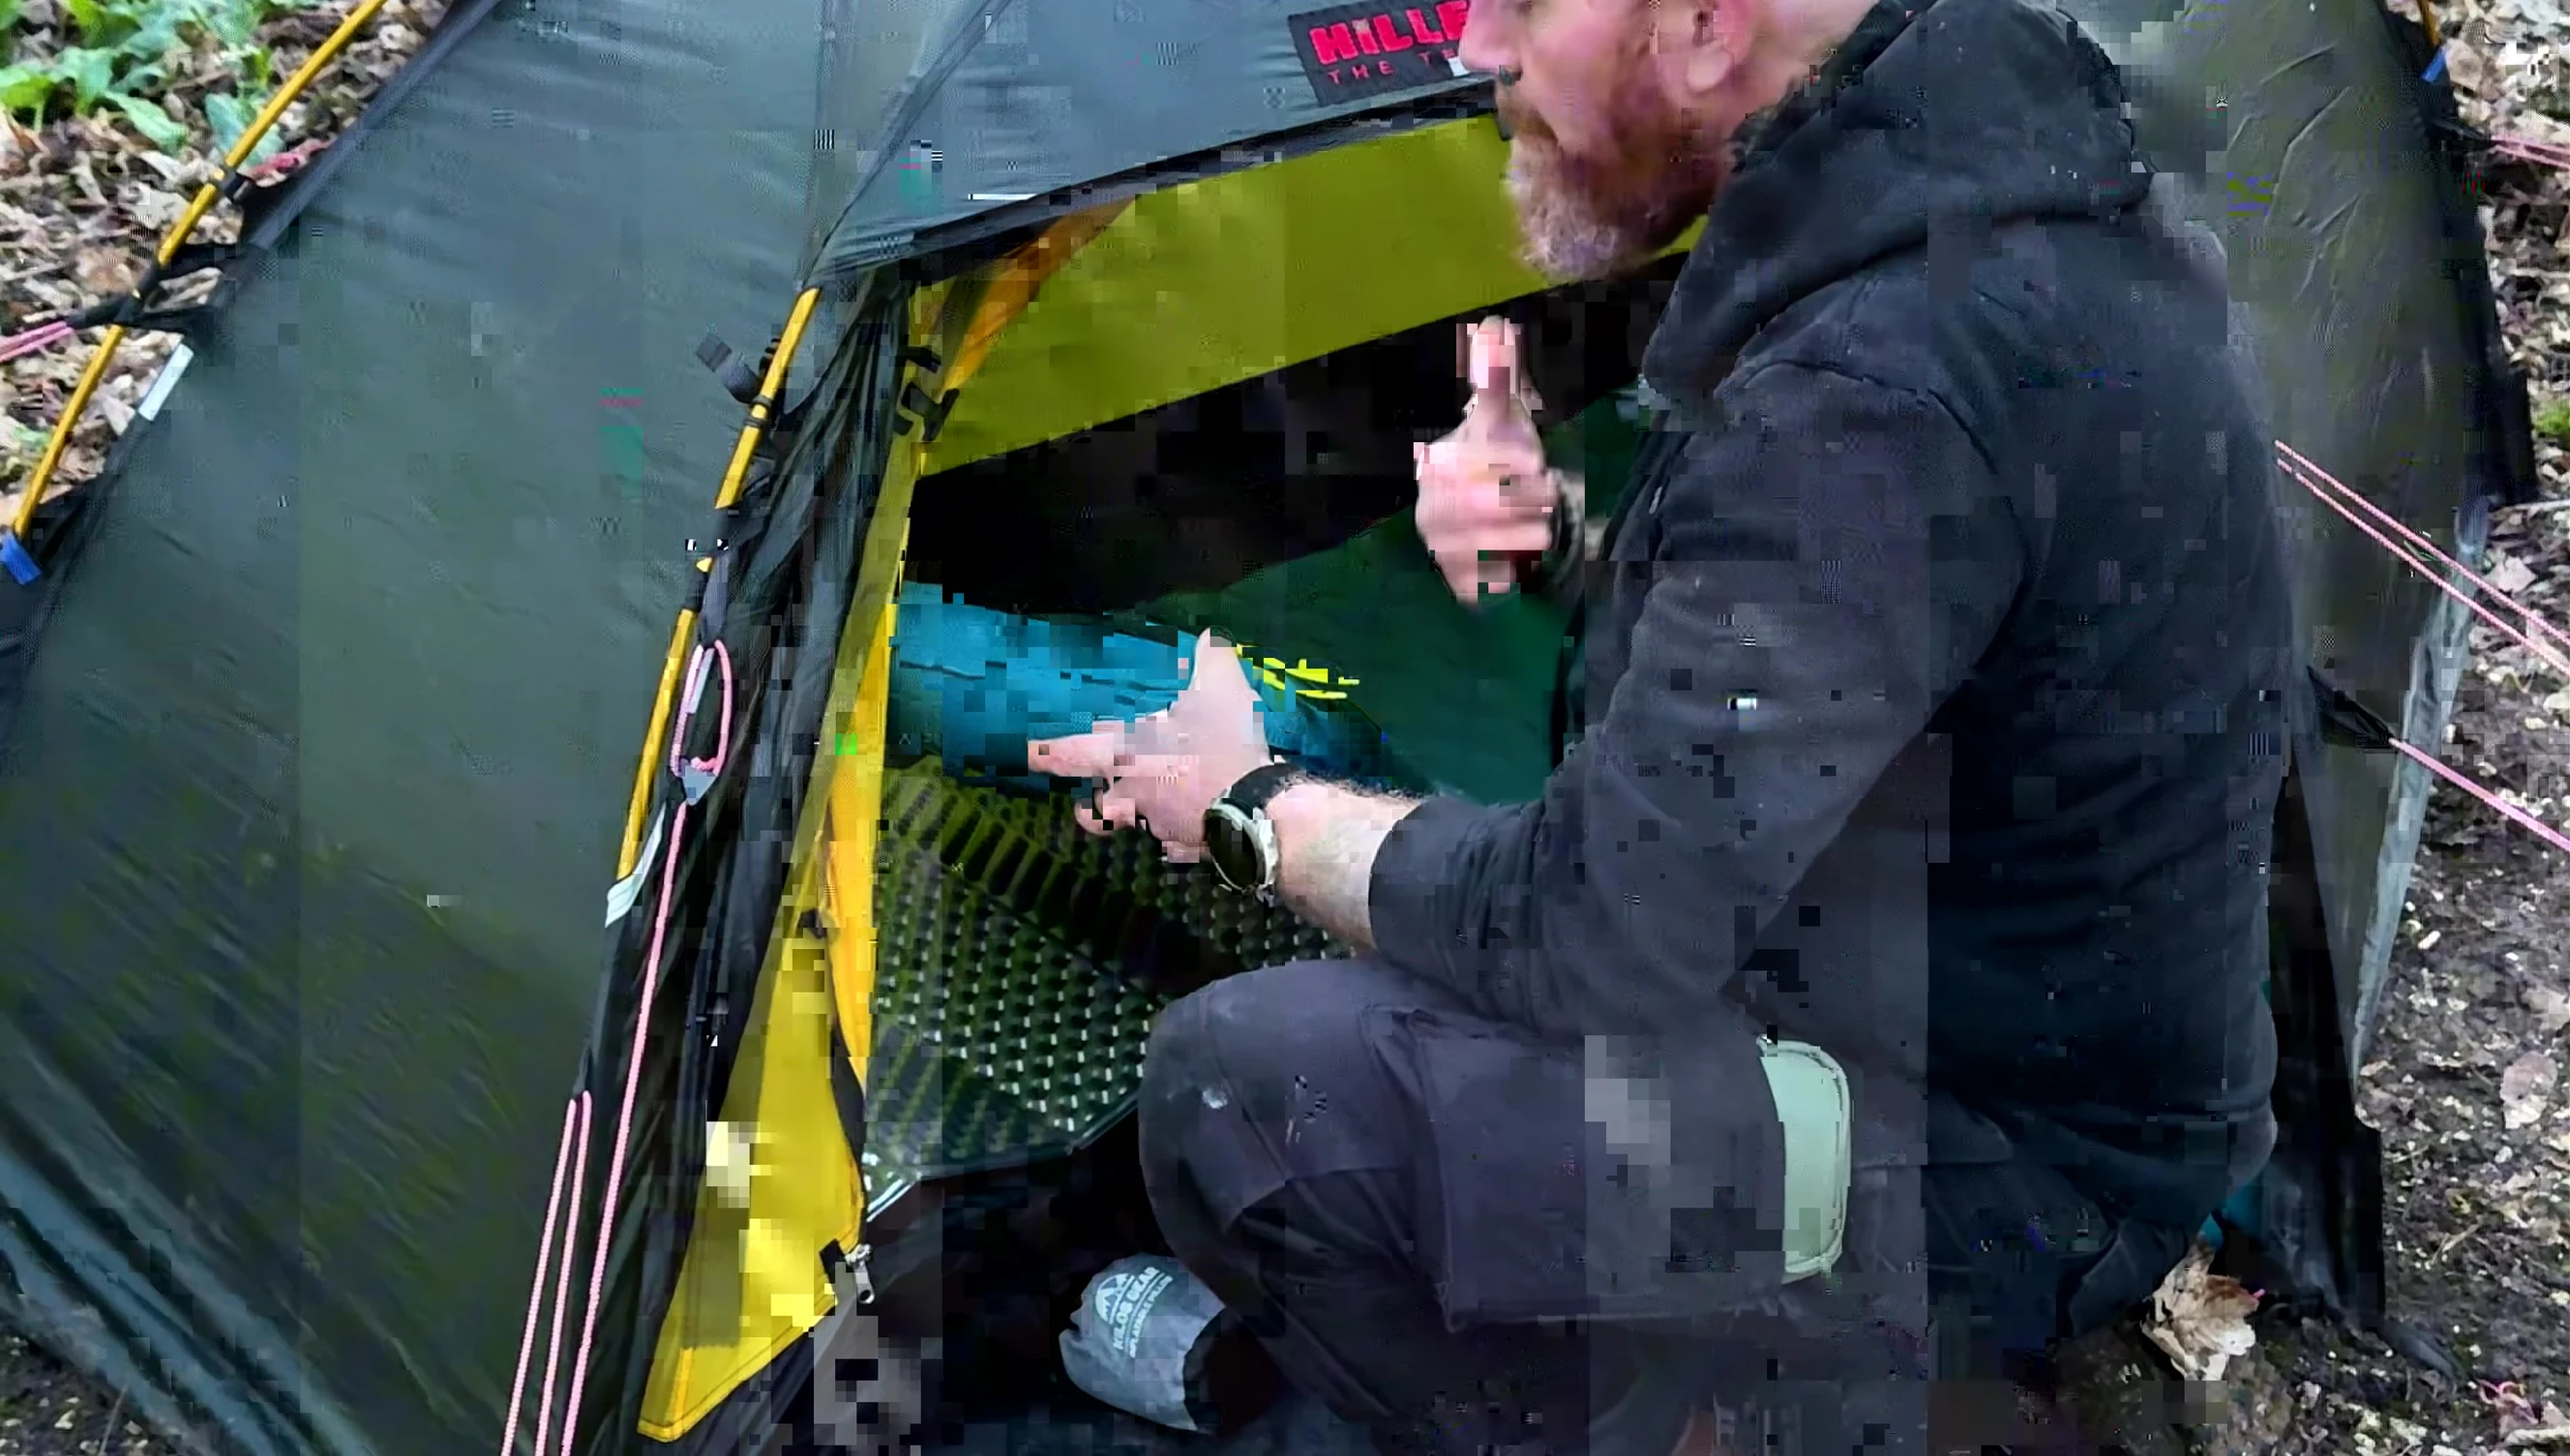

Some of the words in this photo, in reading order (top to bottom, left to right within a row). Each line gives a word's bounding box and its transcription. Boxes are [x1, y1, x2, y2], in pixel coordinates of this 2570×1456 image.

[1309, 1, 1468, 65] HILLE
[1327, 59, 1394, 85] THE
[1113, 1301, 1133, 1350] KILOS
[1126, 1266, 1160, 1301] GEAR
